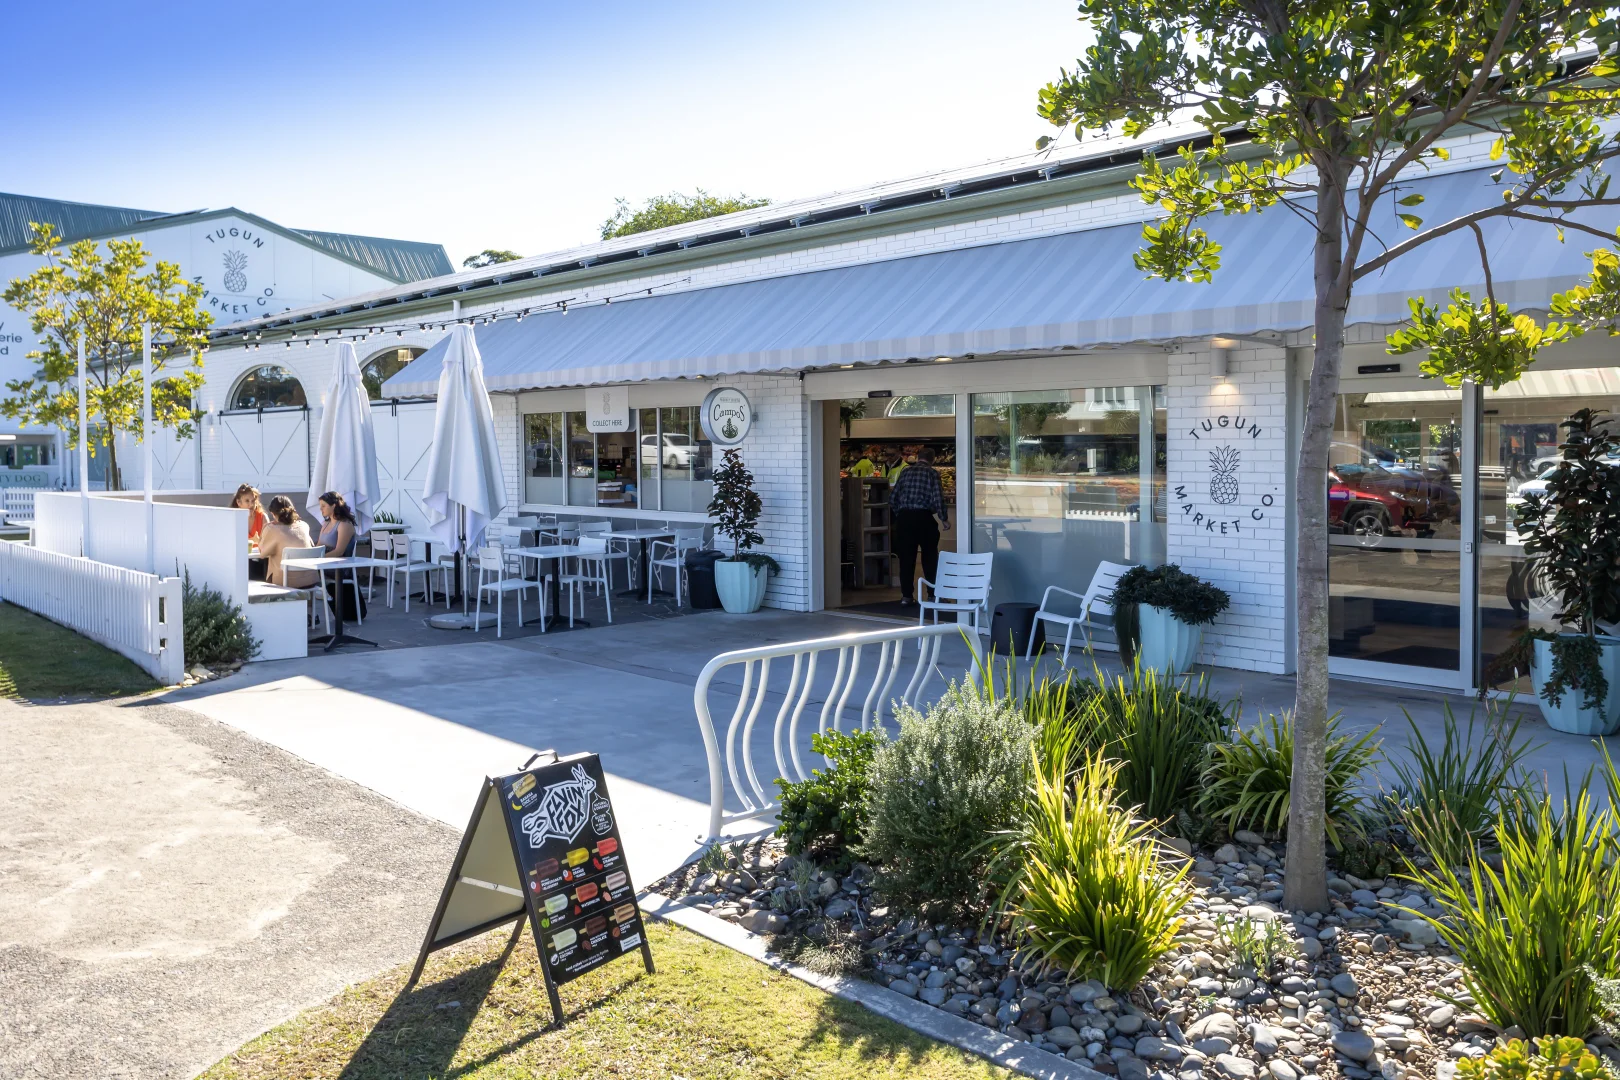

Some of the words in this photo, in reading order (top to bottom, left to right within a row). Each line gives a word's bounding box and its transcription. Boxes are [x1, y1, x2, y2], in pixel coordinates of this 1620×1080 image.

[205, 227, 264, 248] TUGUN
[193, 275, 248, 314] MARKET
[592, 419, 611, 427] COLLECT
[1189, 415, 1262, 440] TUGUN
[14, 474, 41, 483] DOG
[1174, 485, 1240, 534] MARKET
[1251, 487, 1278, 521] CO.
[555, 803, 586, 834] FOX
